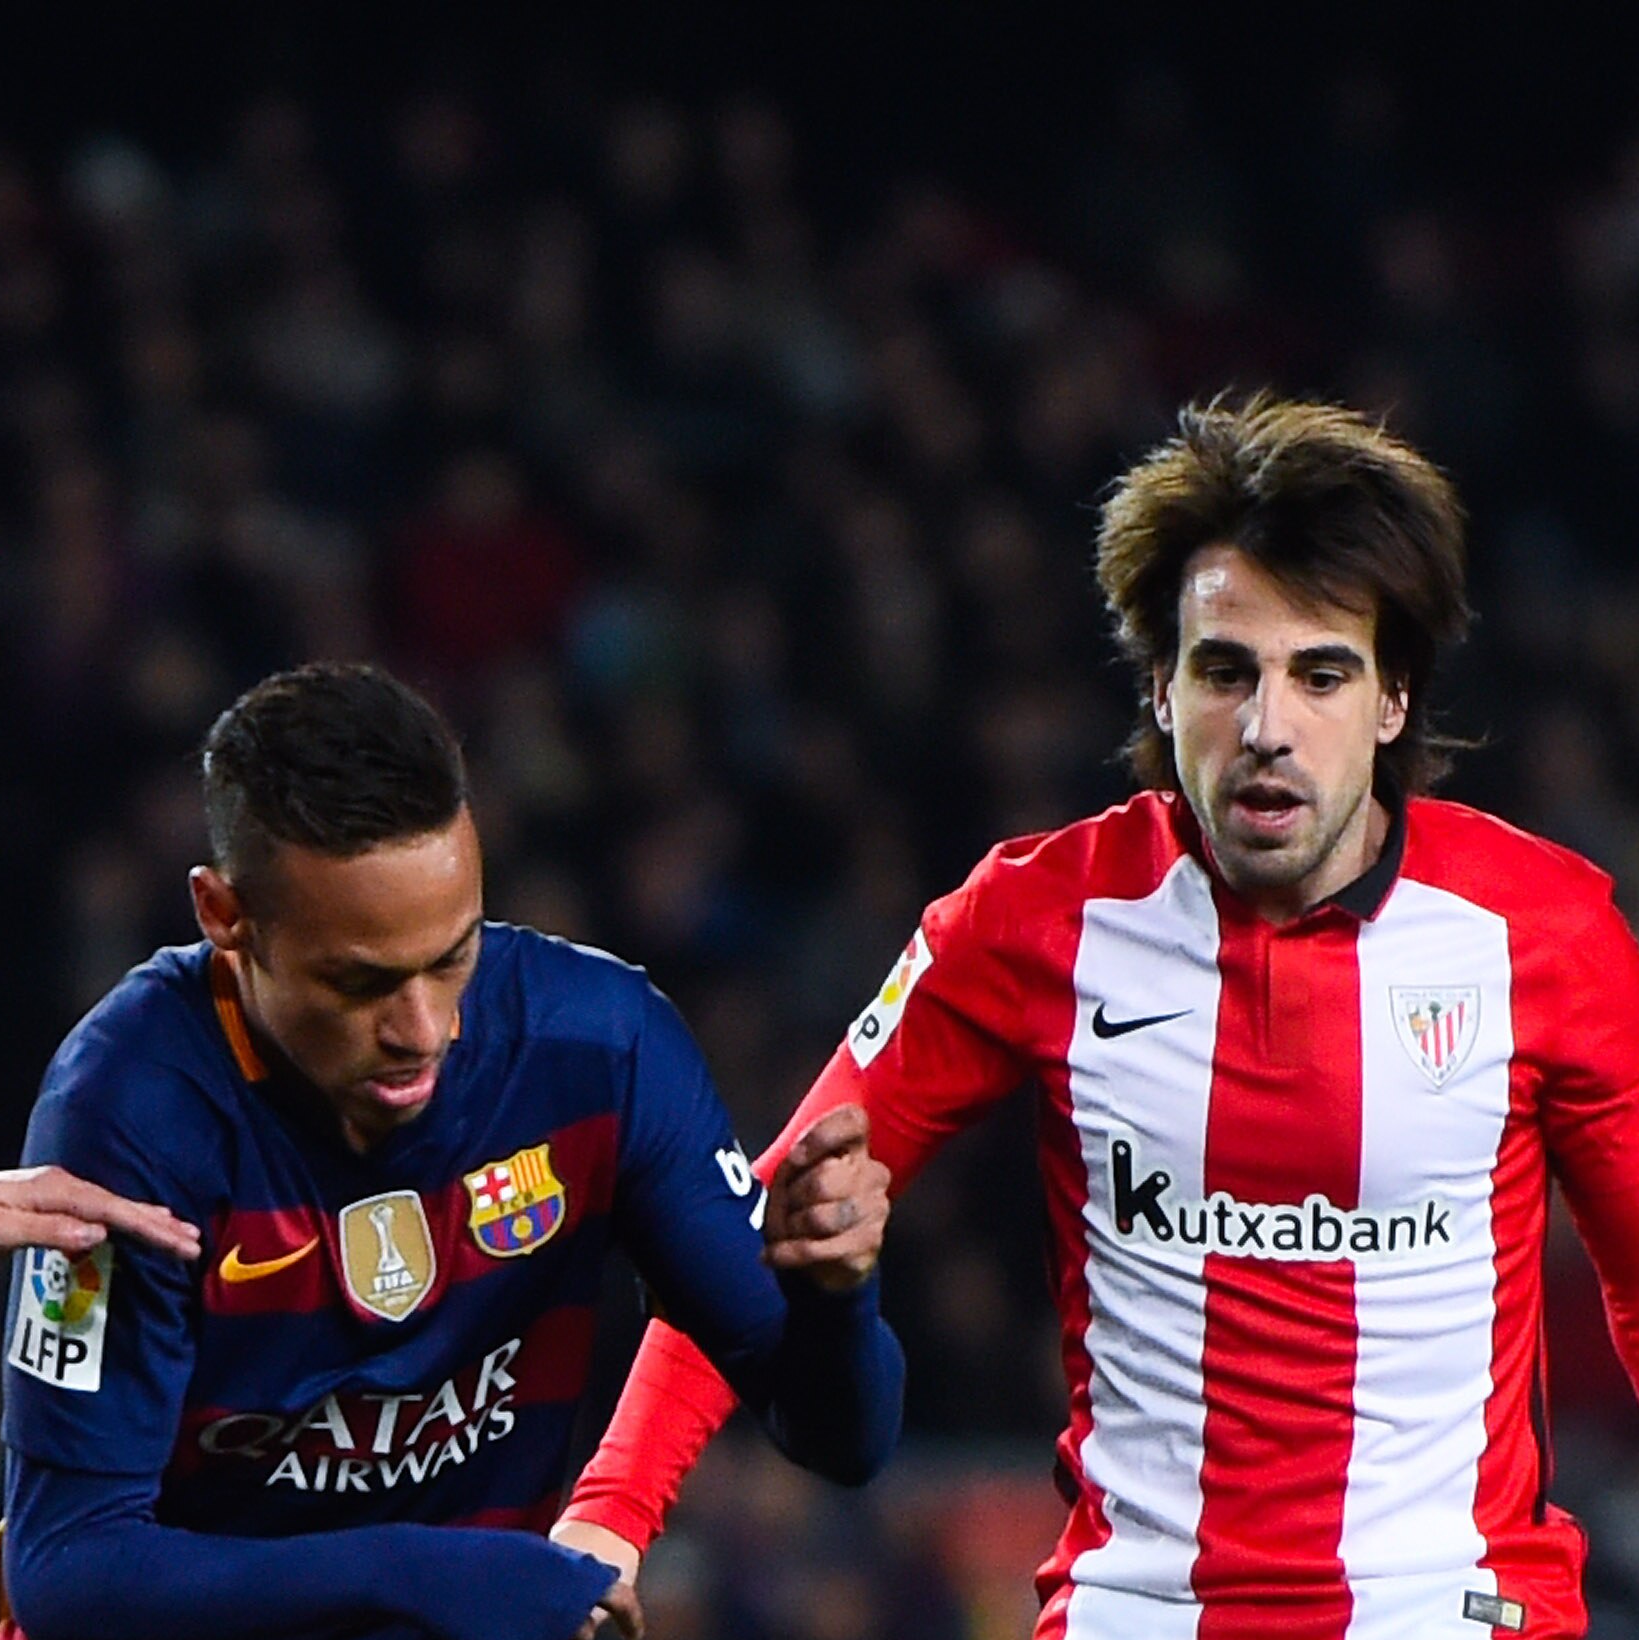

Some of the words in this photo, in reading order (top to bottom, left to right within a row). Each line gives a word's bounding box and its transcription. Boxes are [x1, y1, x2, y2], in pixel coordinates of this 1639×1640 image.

[18, 1316, 89, 1381] LFP
[198, 1337, 522, 1459] QATAR
[265, 1394, 516, 1493] AIRWAYS
